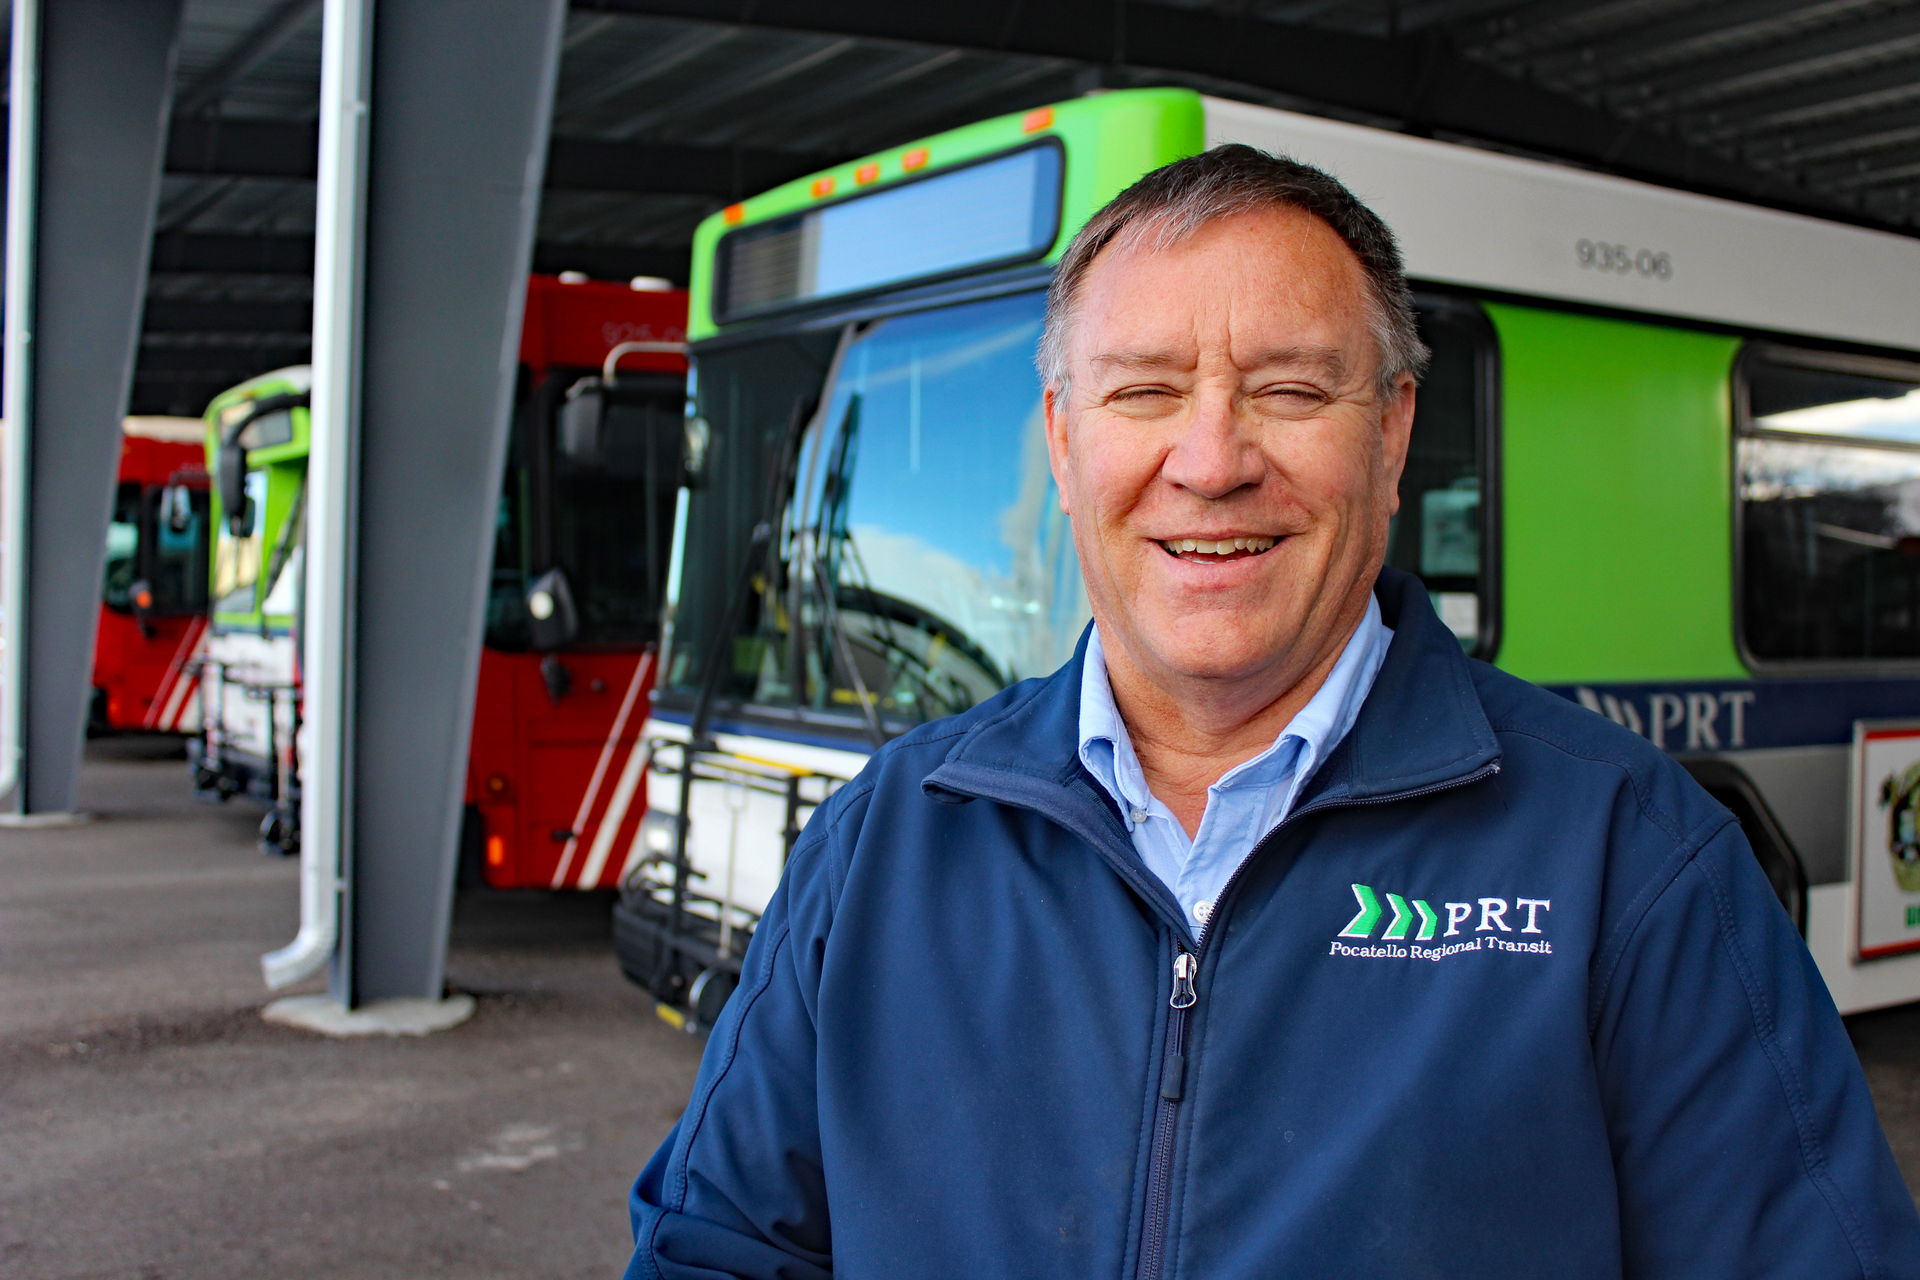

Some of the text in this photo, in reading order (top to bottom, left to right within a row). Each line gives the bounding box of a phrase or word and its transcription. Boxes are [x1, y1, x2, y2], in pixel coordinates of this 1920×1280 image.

[1649, 691, 1756, 749] PRT
[1443, 897, 1551, 938] PRT
[1329, 936, 1553, 962] Pocatello Regional Transit
